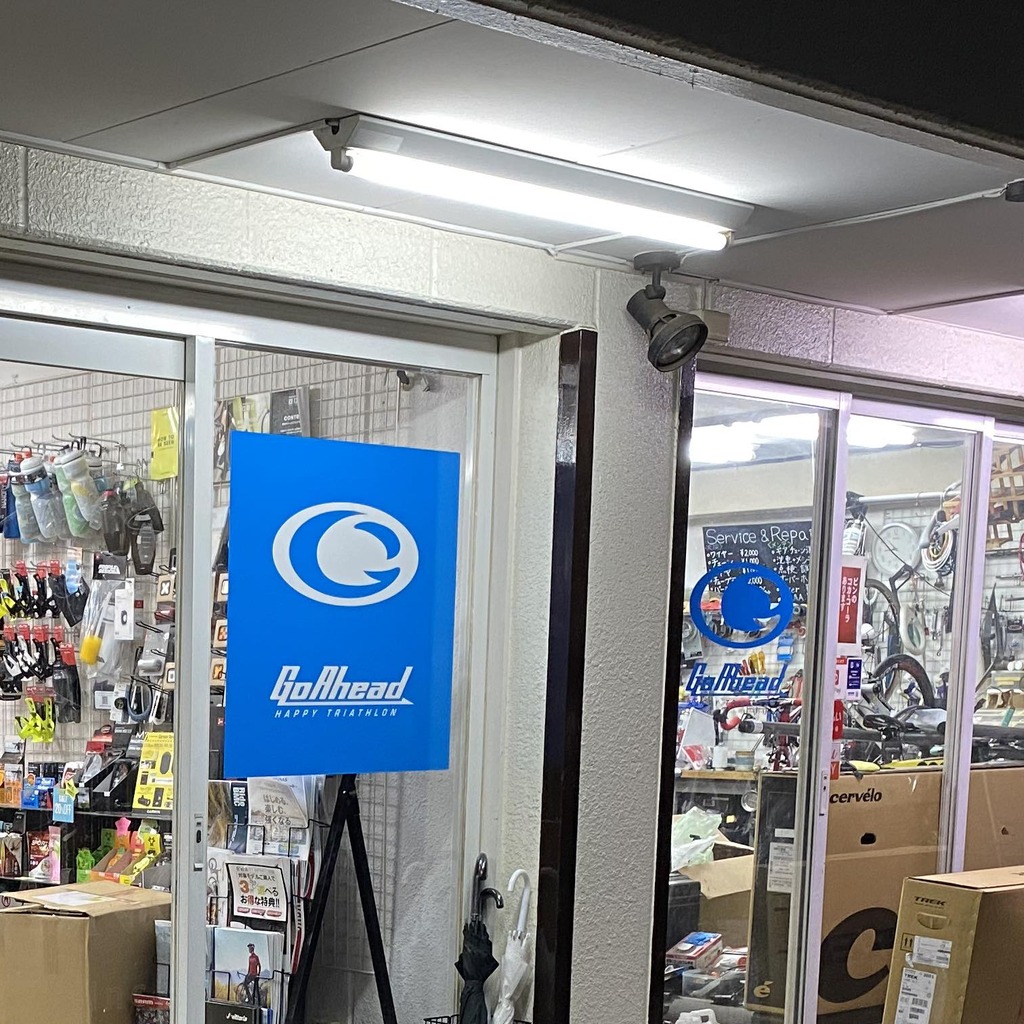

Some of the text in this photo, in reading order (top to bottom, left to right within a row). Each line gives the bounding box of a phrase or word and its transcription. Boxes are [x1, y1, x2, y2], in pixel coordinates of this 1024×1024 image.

[706, 529, 757, 545] Service
[760, 529, 769, 543] &
[270, 665, 414, 703] GoAhead
[685, 662, 788, 693] GoAhead
[274, 708, 397, 718] HAPPY TRIATHLON
[829, 788, 882, 803] cervélo
[914, 896, 947, 906] TREK
